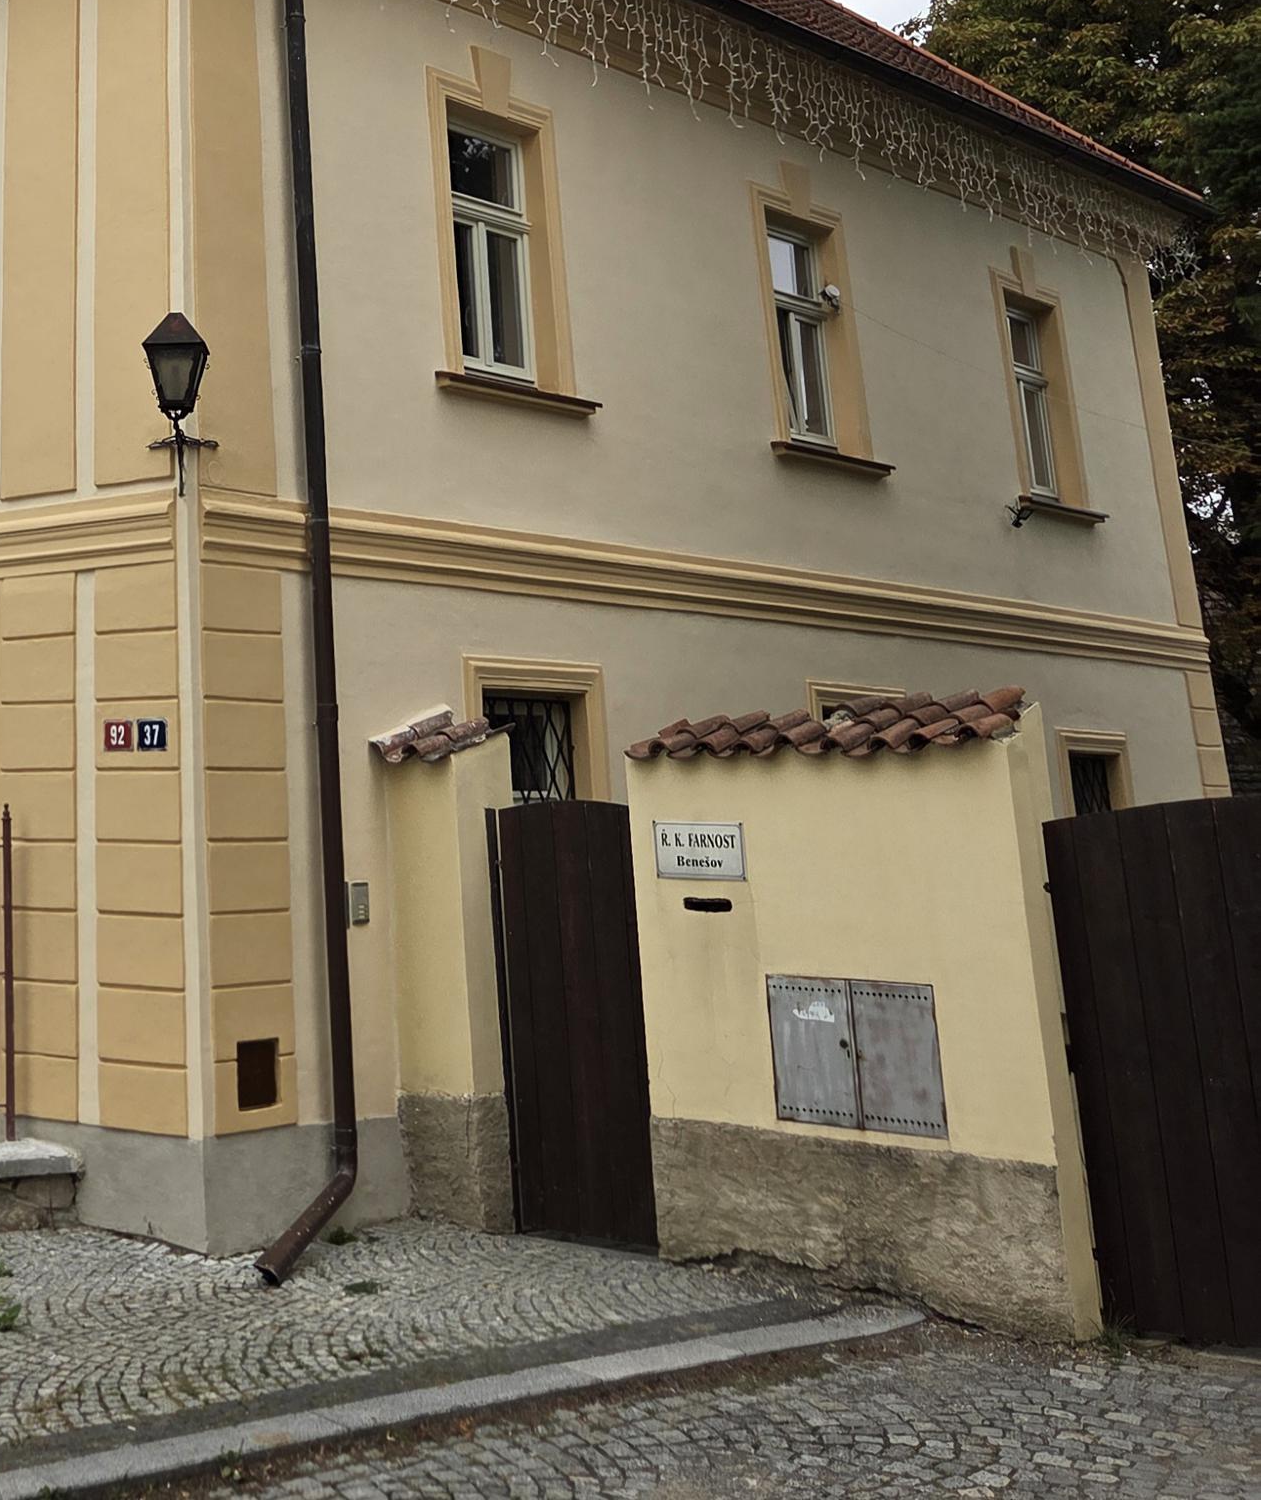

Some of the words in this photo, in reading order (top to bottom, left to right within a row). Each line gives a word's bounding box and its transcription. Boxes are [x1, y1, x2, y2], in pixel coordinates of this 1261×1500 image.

[110, 724, 125, 745] 92
[144, 724, 159, 745] 37
[674, 832, 684, 848] K.
[688, 833, 736, 849] FARNOST
[677, 855, 723, 868] Benešov
